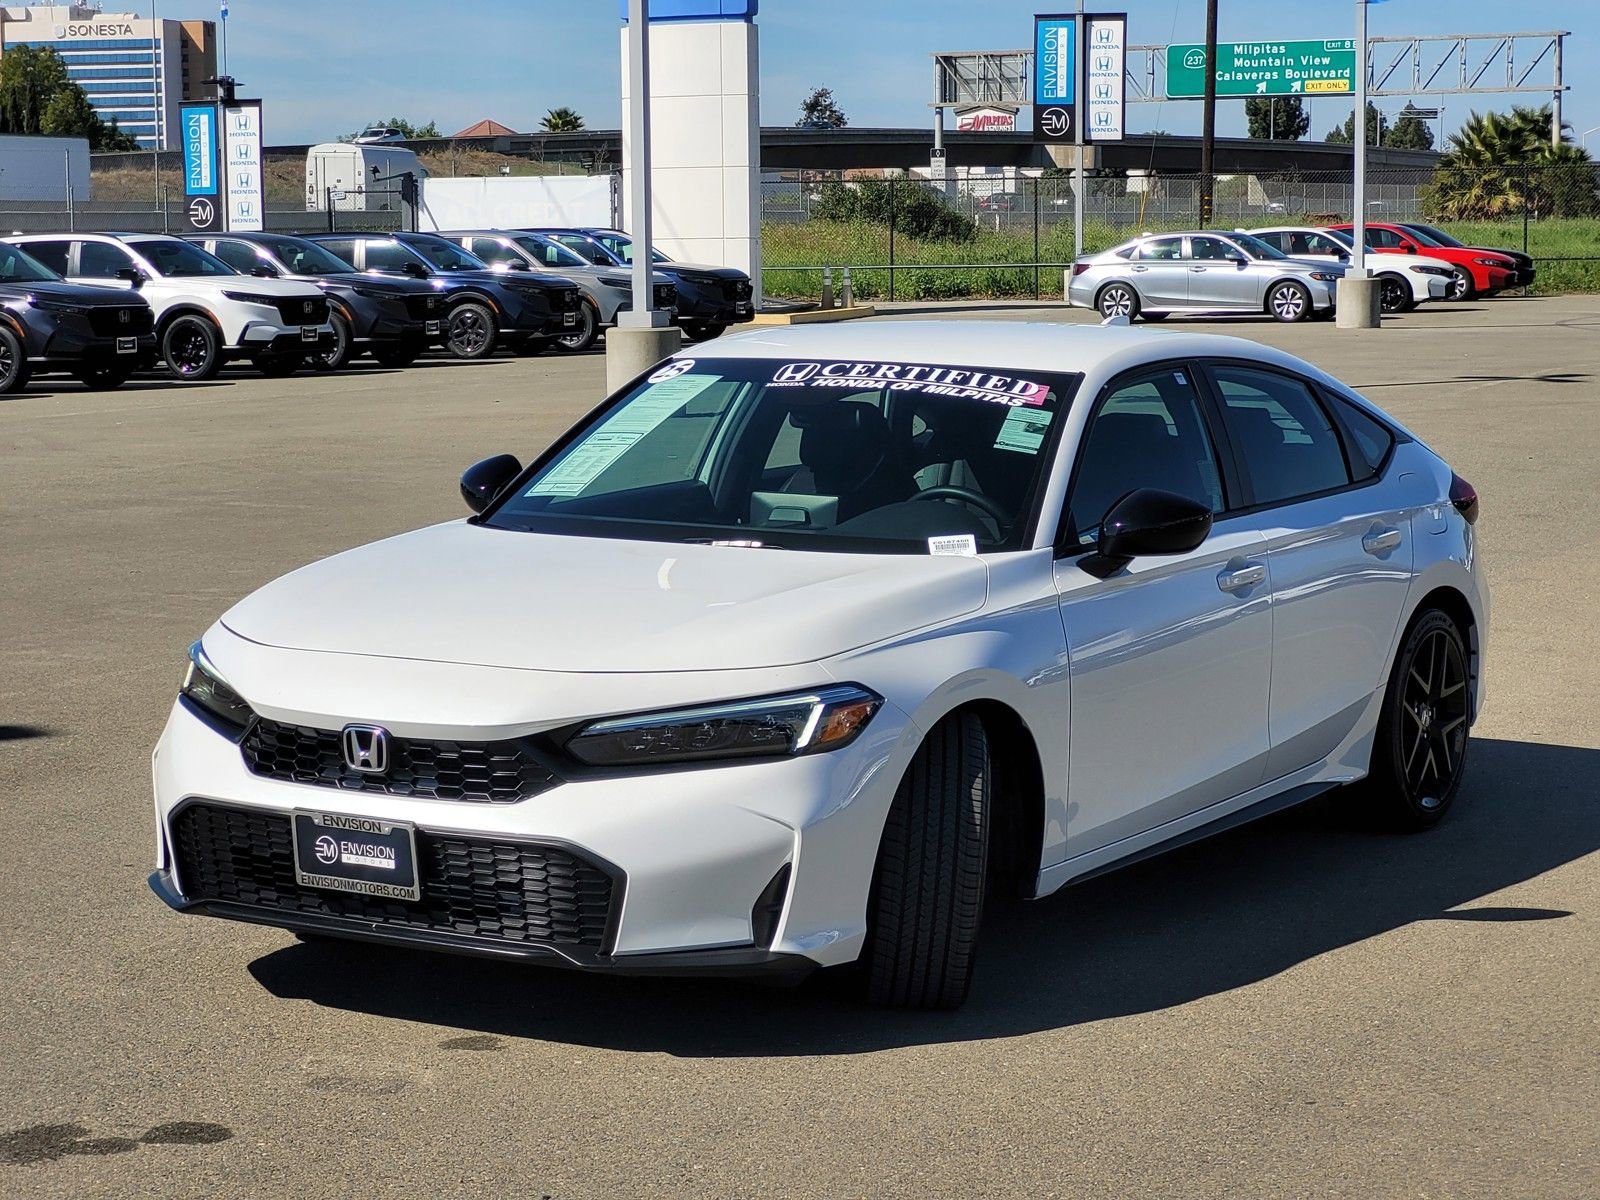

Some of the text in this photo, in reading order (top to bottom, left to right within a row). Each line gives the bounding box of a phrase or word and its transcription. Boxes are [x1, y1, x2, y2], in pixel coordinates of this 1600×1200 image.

[68, 24, 134, 37] SONESTA
[1233, 44, 1286, 56] Milpitas
[1327, 41, 1342, 49] EXIT
[1043, 27, 1058, 98] ENVISION
[1187, 56, 1204, 65] 237
[1233, 55, 1331, 67] Mountain View
[1215, 67, 1350, 81] Calaveras Boulevard
[1305, 81, 1348, 90] EXIT ONLY
[188, 114, 201, 188] ENVISION
[821, 363, 1039, 396] CERTIFIED
[810, 379, 1026, 407] HONDA OF MILPITAS
[322, 815, 382, 833] ENVISION
[340, 841, 395, 860] ENVISION
[345, 856, 392, 867] MOTORS
[301, 875, 416, 900] ENVISIONMOTORS.COM
